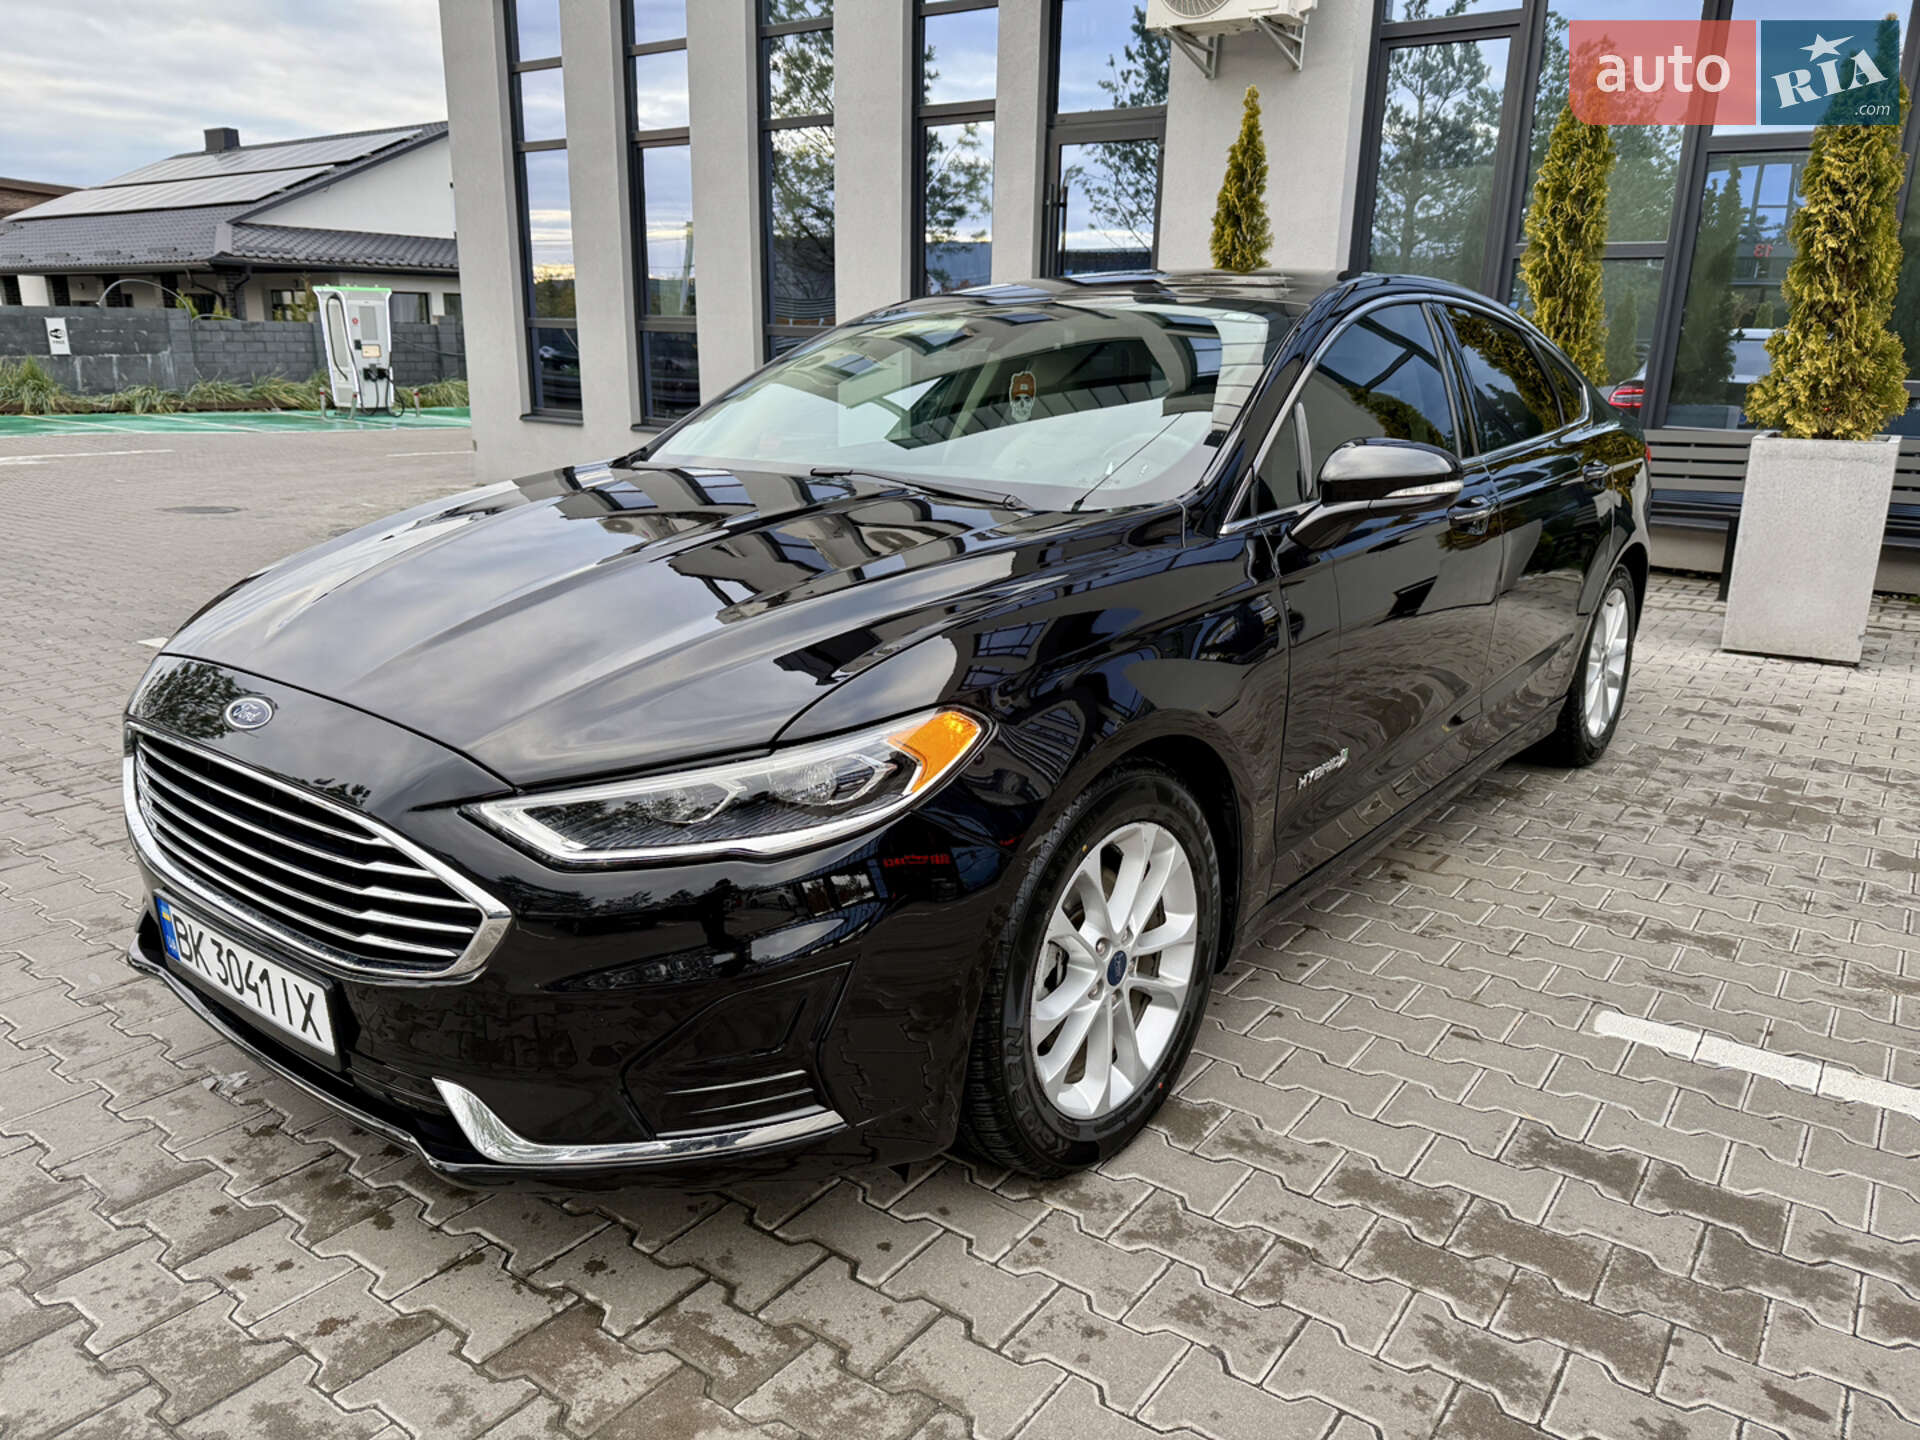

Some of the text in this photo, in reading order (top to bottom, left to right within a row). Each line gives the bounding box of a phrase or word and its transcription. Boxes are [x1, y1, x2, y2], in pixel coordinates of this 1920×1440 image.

[172, 913, 324, 1043] BK 3041 IX
